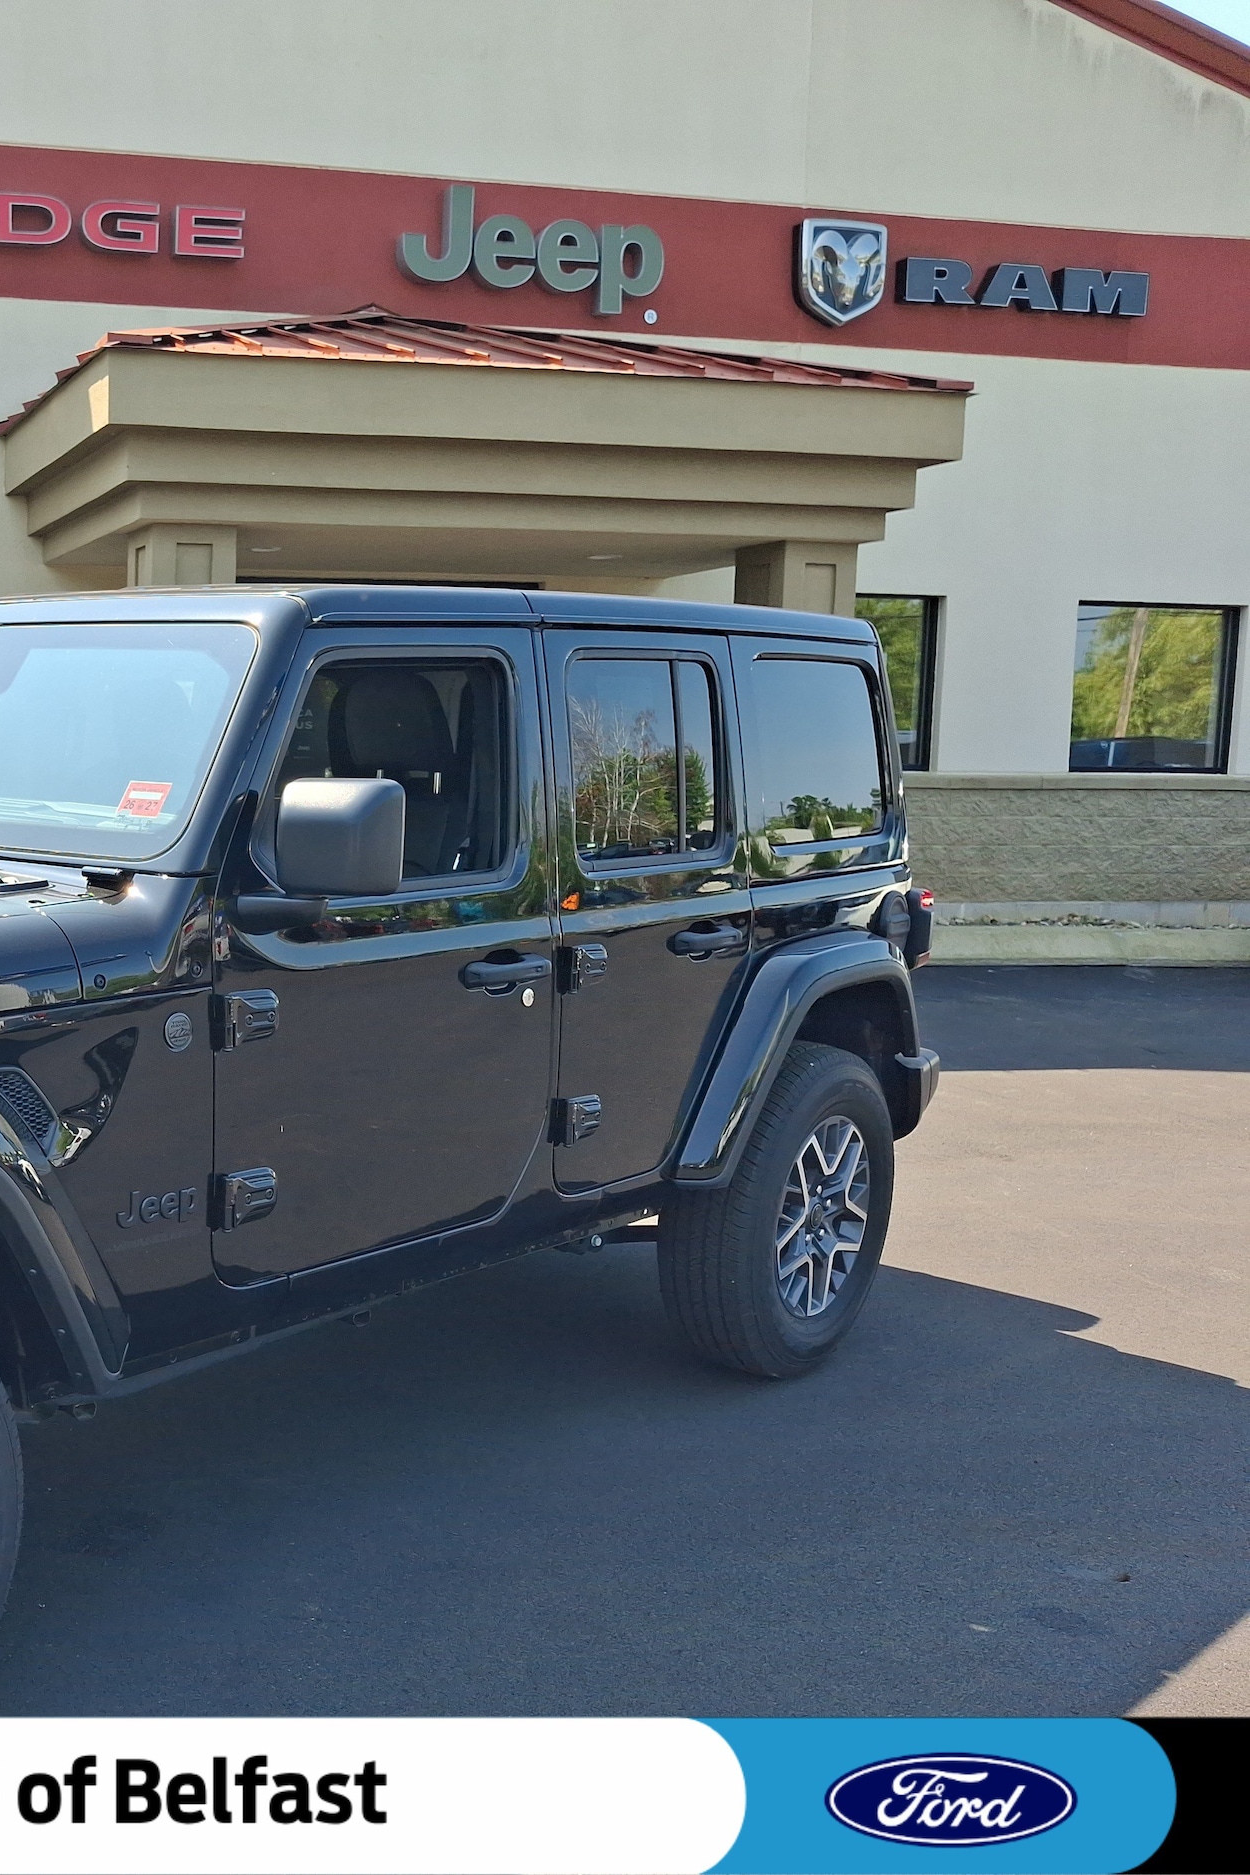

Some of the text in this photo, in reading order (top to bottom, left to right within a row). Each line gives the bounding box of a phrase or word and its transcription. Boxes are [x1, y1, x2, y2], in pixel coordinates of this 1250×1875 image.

[397, 185, 665, 315] Jeep
[897, 256, 1150, 317] RAM
[116, 1187, 197, 1228] Jeep
